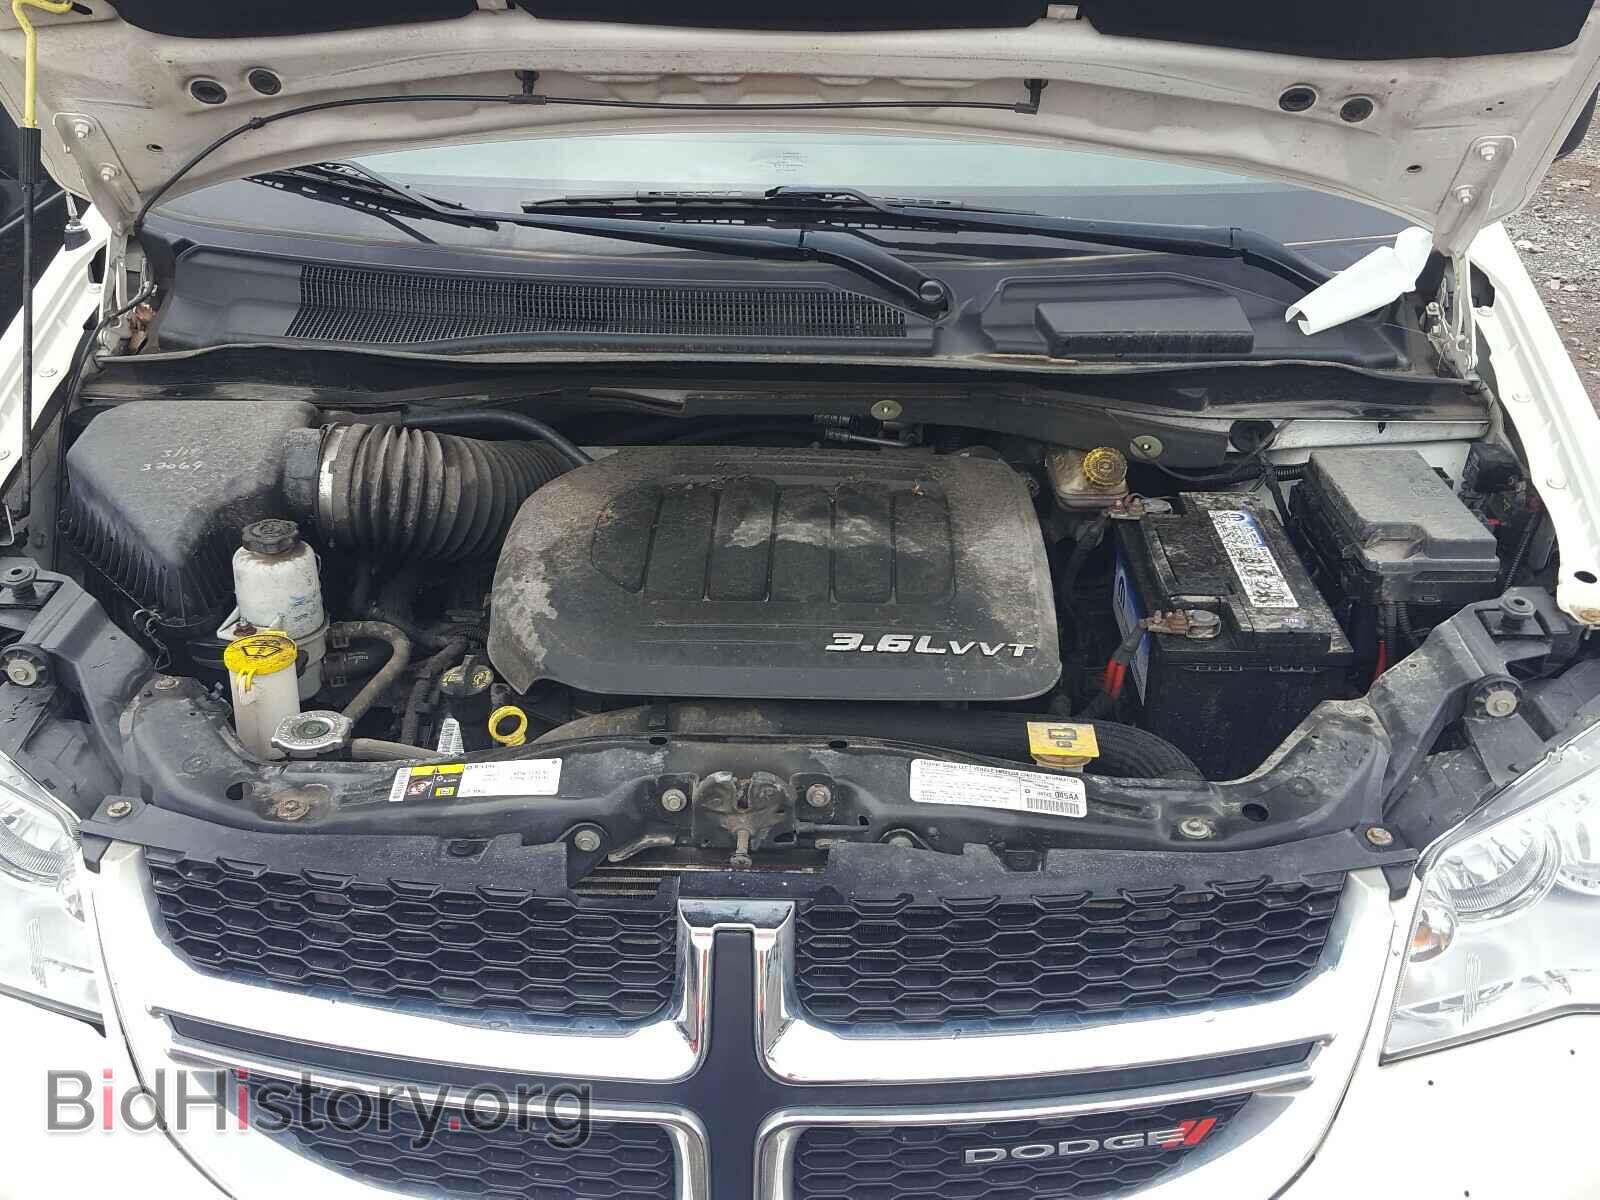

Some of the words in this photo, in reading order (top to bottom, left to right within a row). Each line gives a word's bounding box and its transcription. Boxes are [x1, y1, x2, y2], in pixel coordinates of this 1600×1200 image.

[825, 632, 946, 654] 3.6L
[949, 640, 1034, 657] VVT
[964, 1127, 1185, 1164] DODGE
